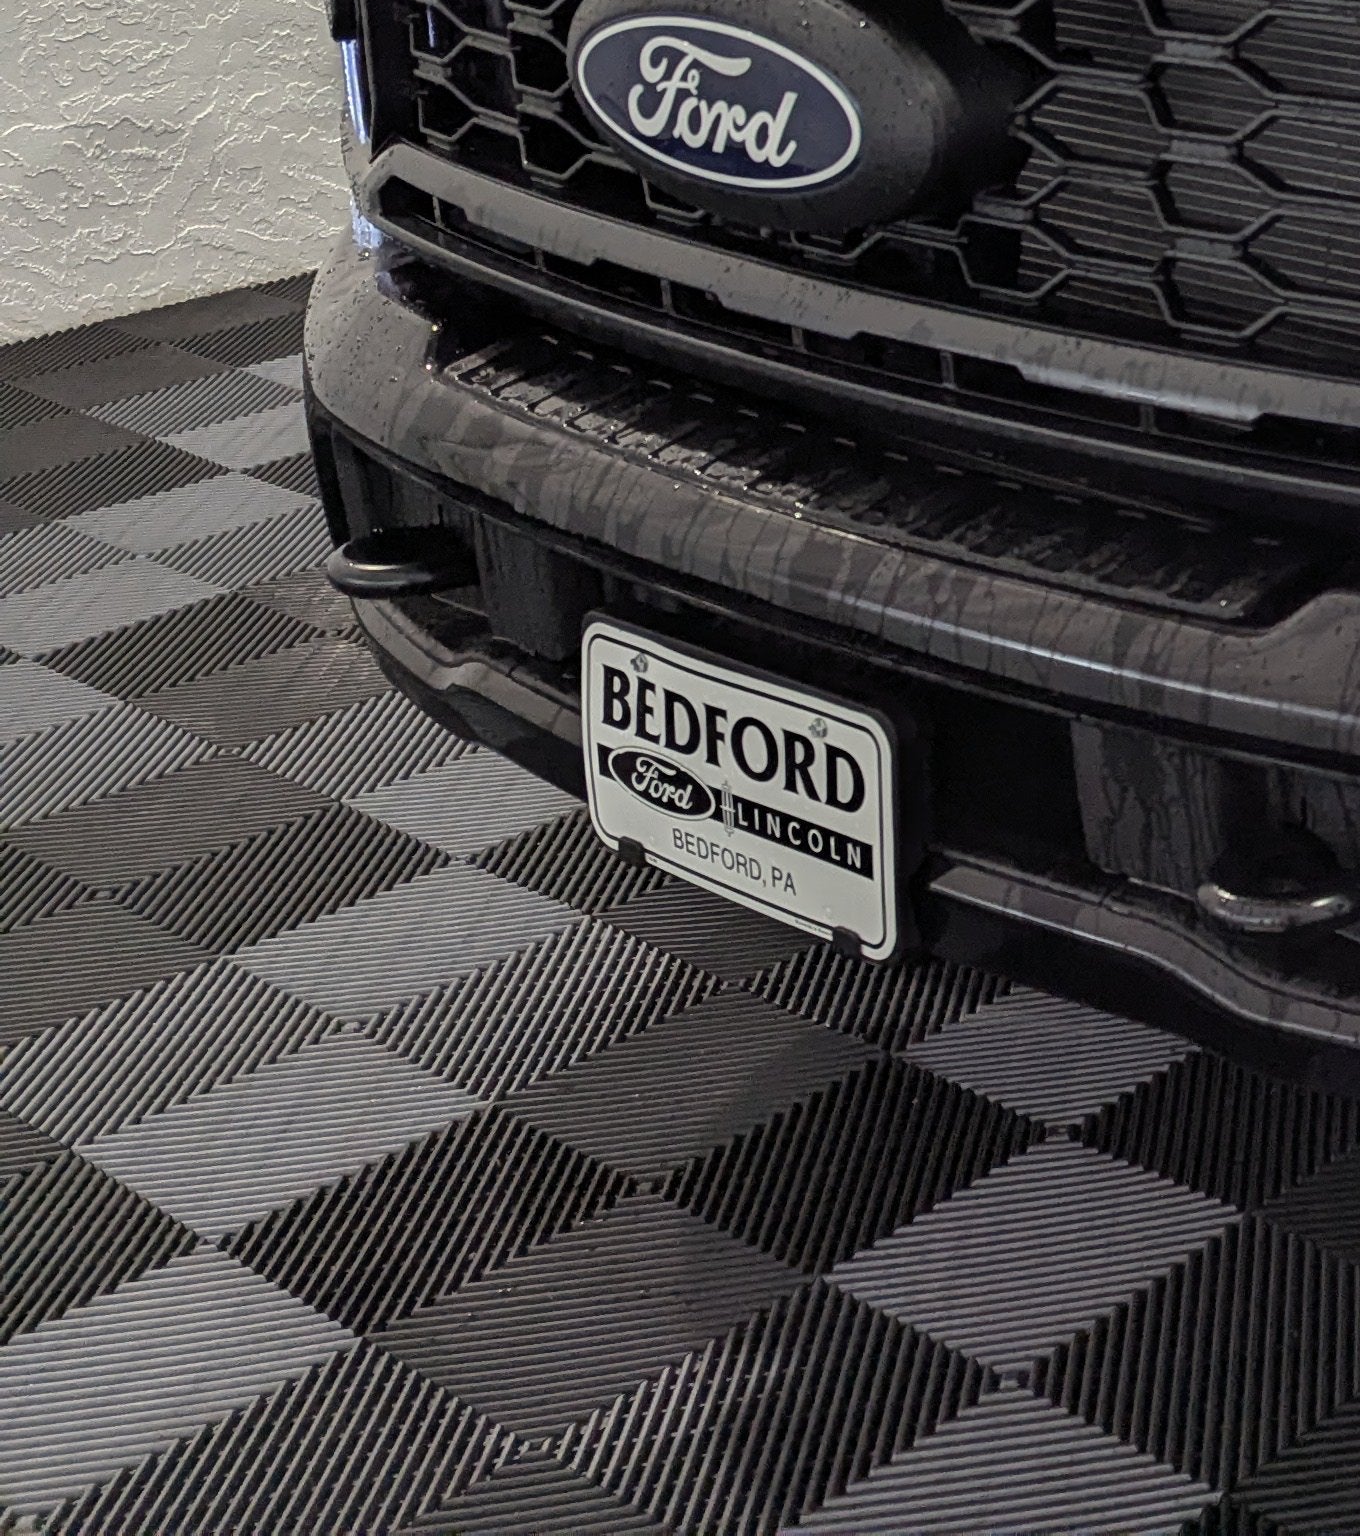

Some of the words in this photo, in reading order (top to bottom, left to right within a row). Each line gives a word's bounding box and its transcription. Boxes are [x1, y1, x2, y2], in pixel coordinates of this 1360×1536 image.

[627, 35, 799, 167] Ford
[600, 663, 867, 814] BEDFORD
[631, 754, 695, 811] Ford
[672, 828, 768, 888] BEDFORD,
[771, 867, 797, 897] PA
[737, 802, 863, 870] LINCOLN
